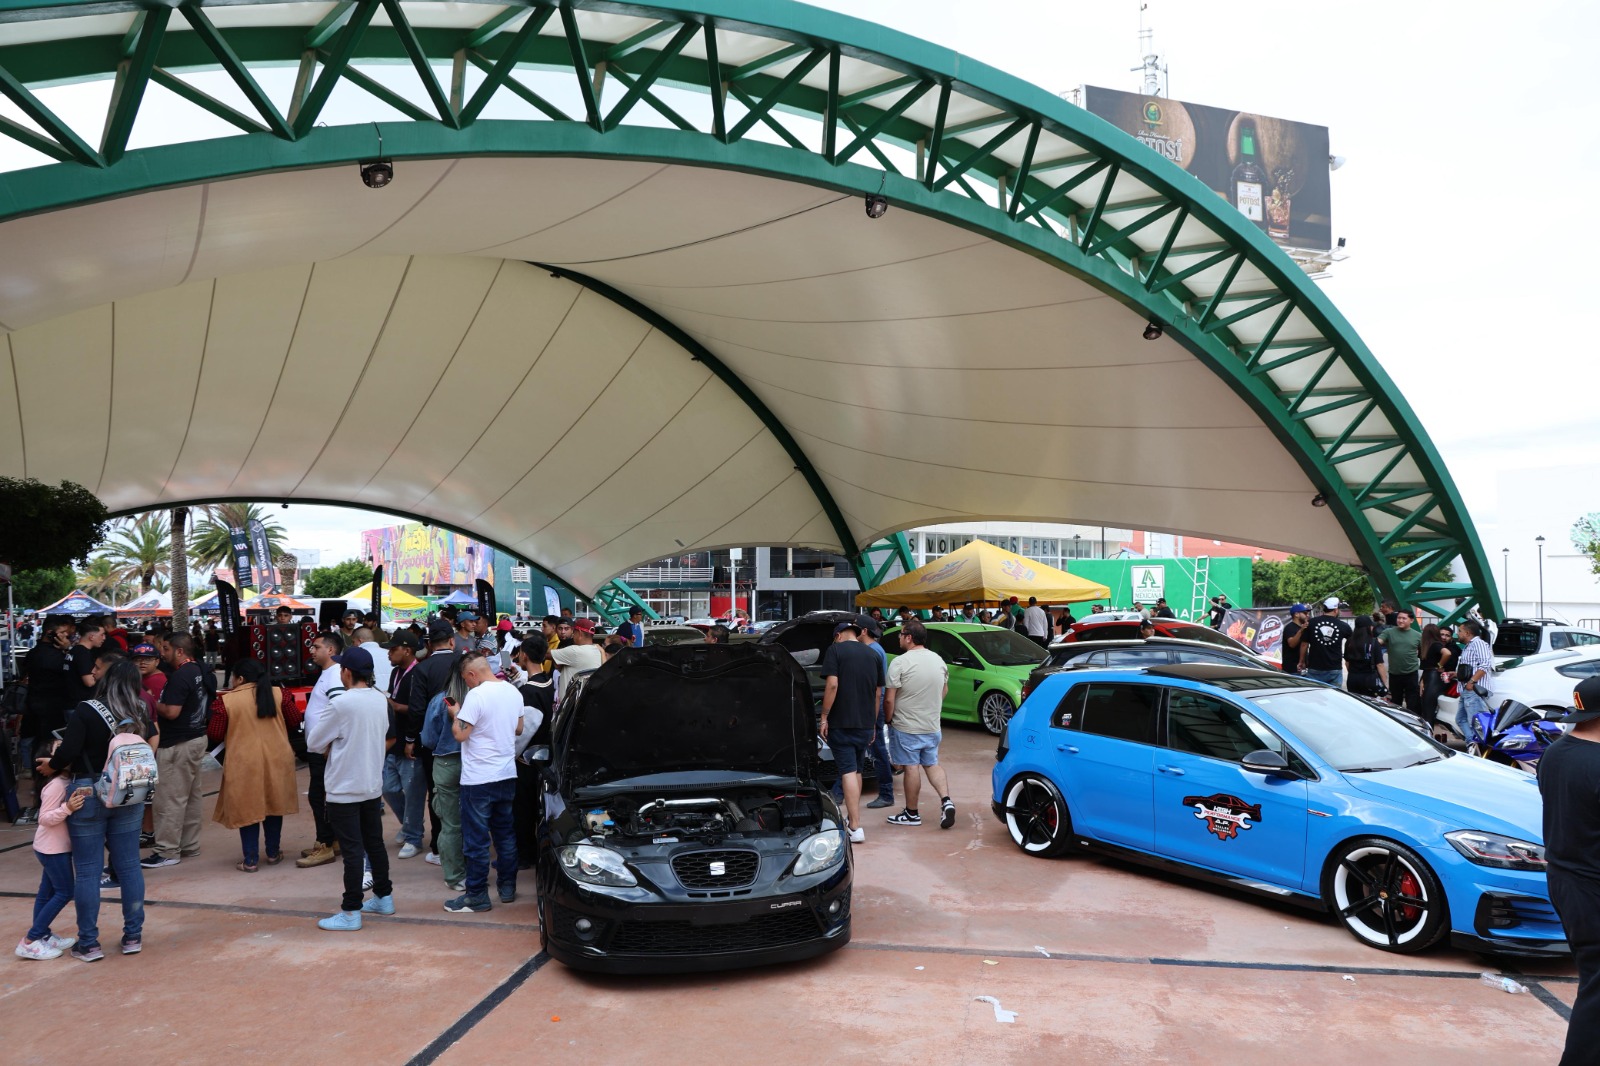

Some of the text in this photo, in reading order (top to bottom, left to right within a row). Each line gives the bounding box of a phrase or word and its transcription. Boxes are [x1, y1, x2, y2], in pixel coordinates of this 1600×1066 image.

[1213, 805, 1232, 815] HIGH
[1204, 809, 1241, 822] PERFORMANCE
[770, 900, 802, 909] CUPRA
